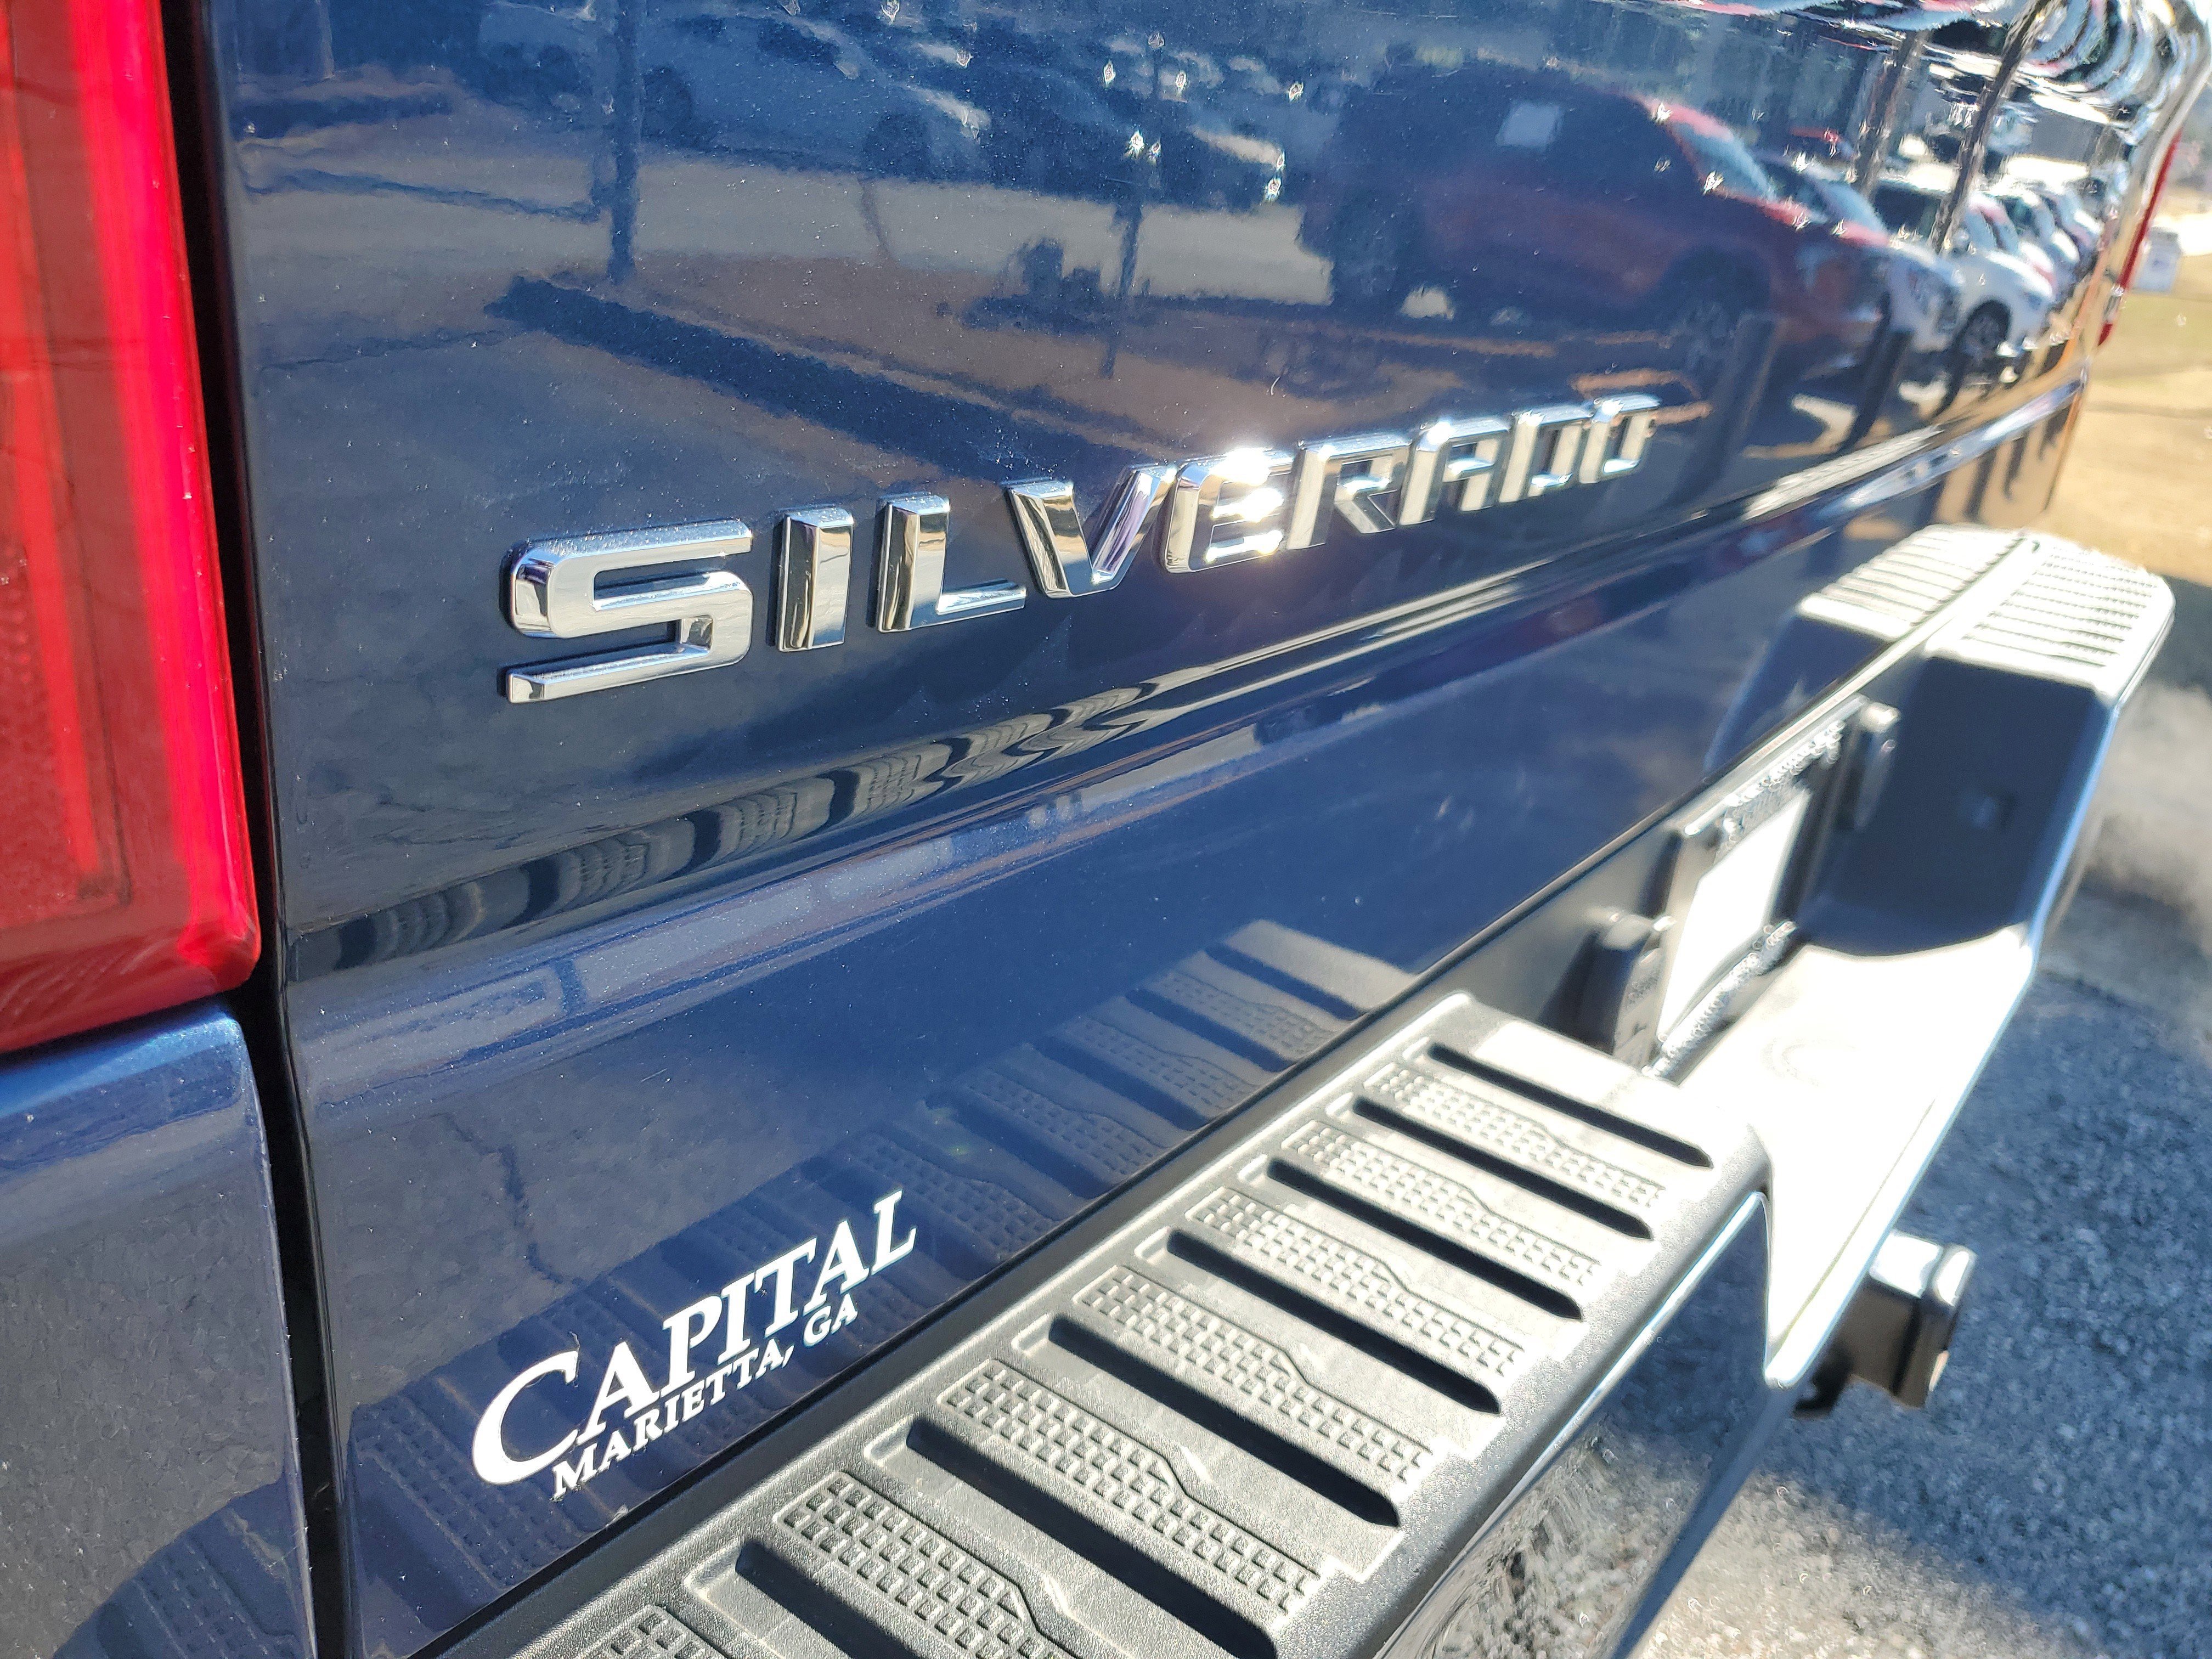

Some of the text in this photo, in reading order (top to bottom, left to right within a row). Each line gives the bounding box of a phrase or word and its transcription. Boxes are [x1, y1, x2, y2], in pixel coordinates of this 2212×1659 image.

[505, 394, 1660, 704] SILVERADO
[472, 1189, 916, 1485] CAPITAL
[551, 1293, 859, 1500] MARIETTA, GA
